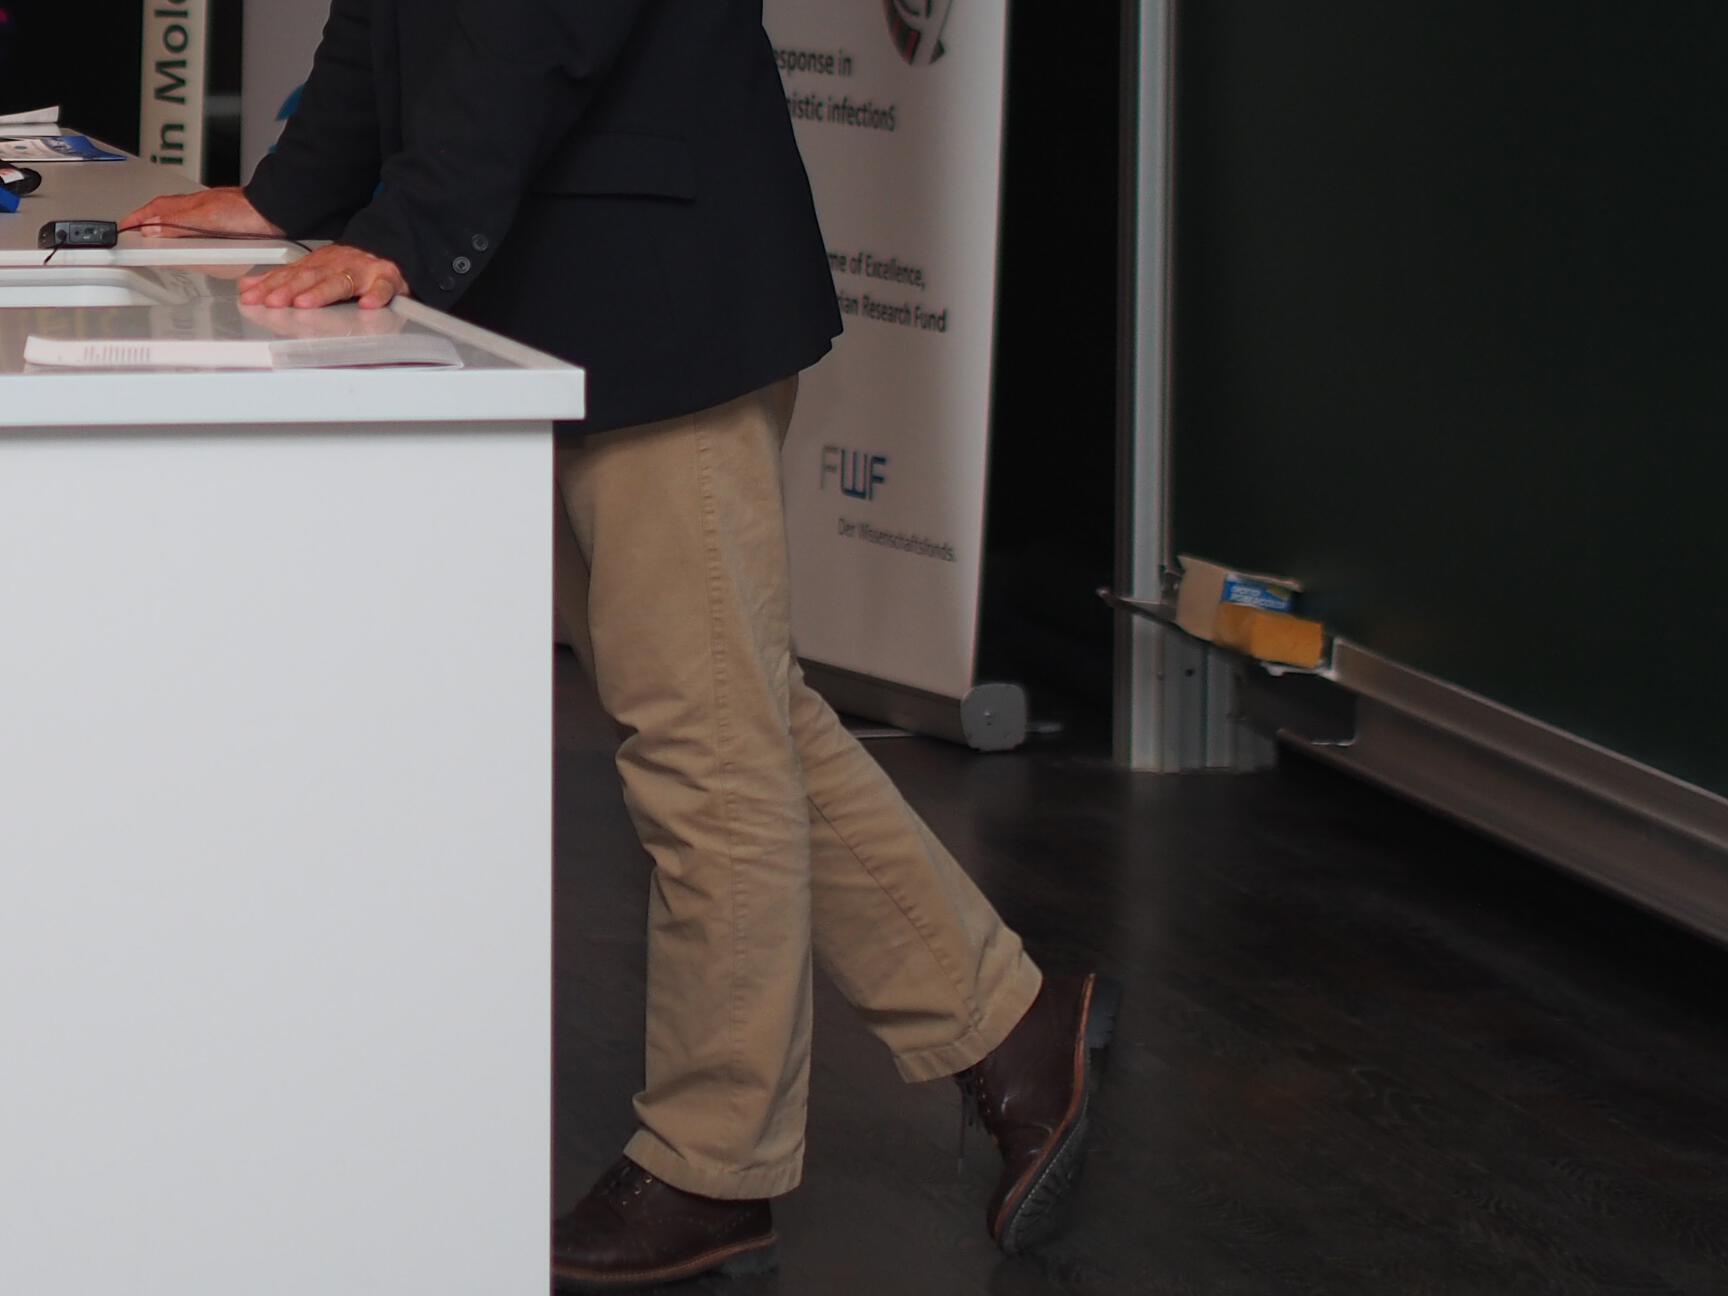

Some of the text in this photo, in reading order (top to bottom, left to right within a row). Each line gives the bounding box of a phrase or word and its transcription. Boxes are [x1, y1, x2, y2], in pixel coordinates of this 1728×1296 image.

[837, 48, 853, 77] in
[150, 123, 185, 166] in
[849, 252, 863, 276] of
[914, 305, 948, 334] Fund
[820, 444, 886, 501] FWF
